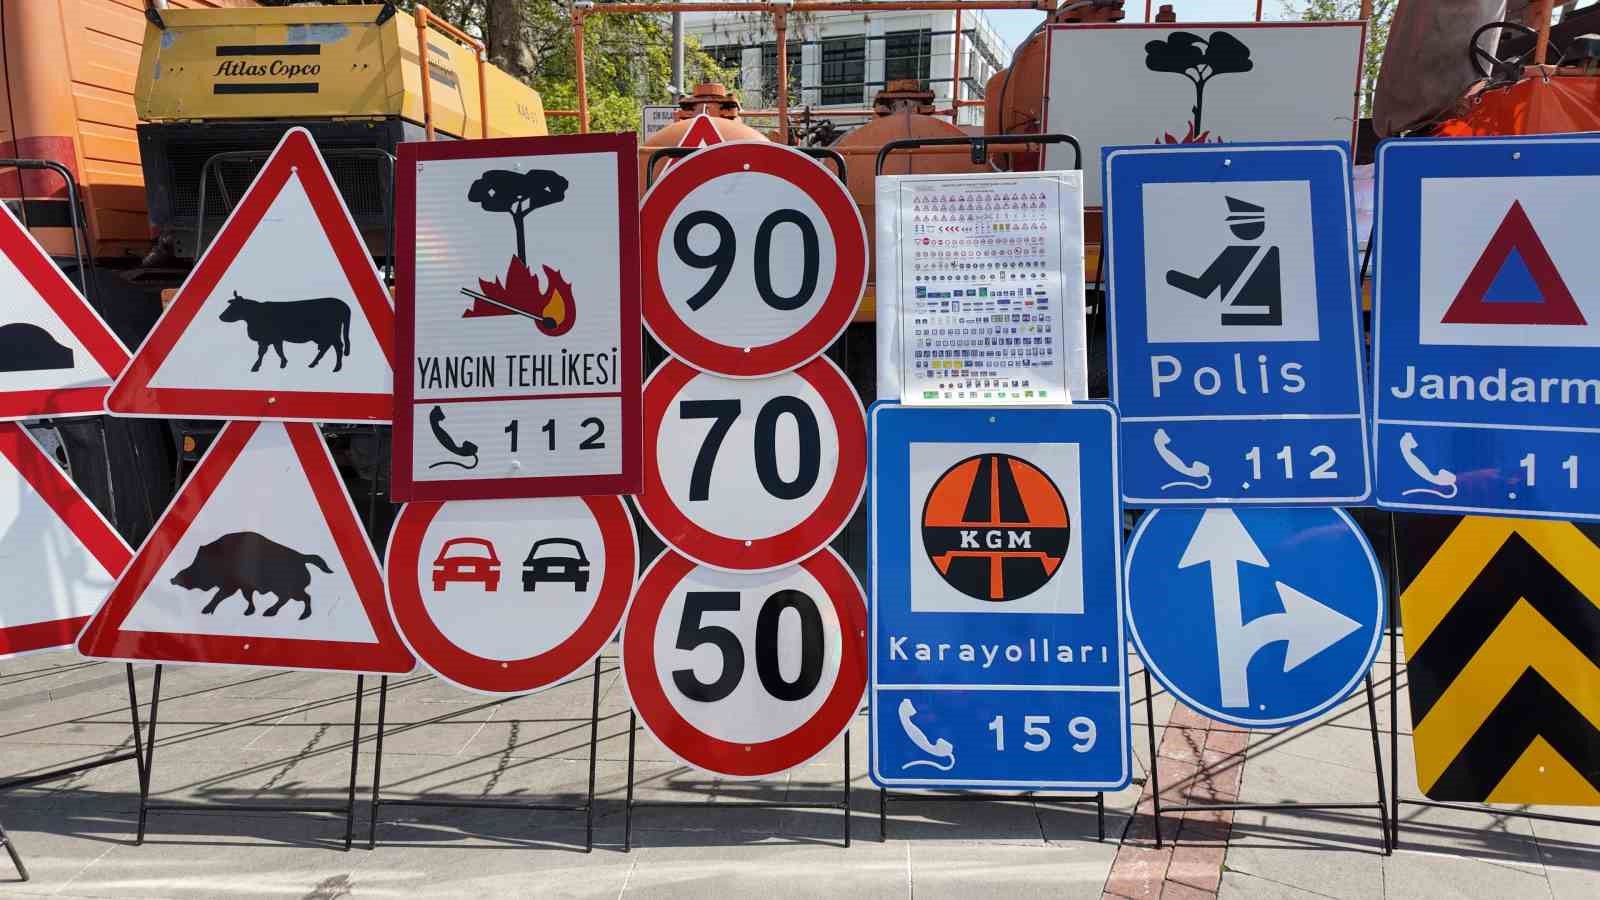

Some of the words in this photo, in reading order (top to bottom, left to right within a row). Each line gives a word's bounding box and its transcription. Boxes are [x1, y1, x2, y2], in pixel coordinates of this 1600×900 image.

[213, 60, 267, 76] Atlas
[269, 60, 320, 78] Copco
[673, 208, 820, 312] 90
[417, 355, 495, 389] YANGIN
[506, 347, 618, 387] TEHLİKESİ
[1151, 353, 1306, 397] Polis
[504, 416, 606, 453] 112
[679, 395, 821, 502] 70
[1245, 445, 1338, 480] 112
[960, 530, 1032, 549] KGM
[672, 588, 825, 703] 50
[889, 636, 1108, 668] Karayolları
[988, 715, 1097, 753] 159
